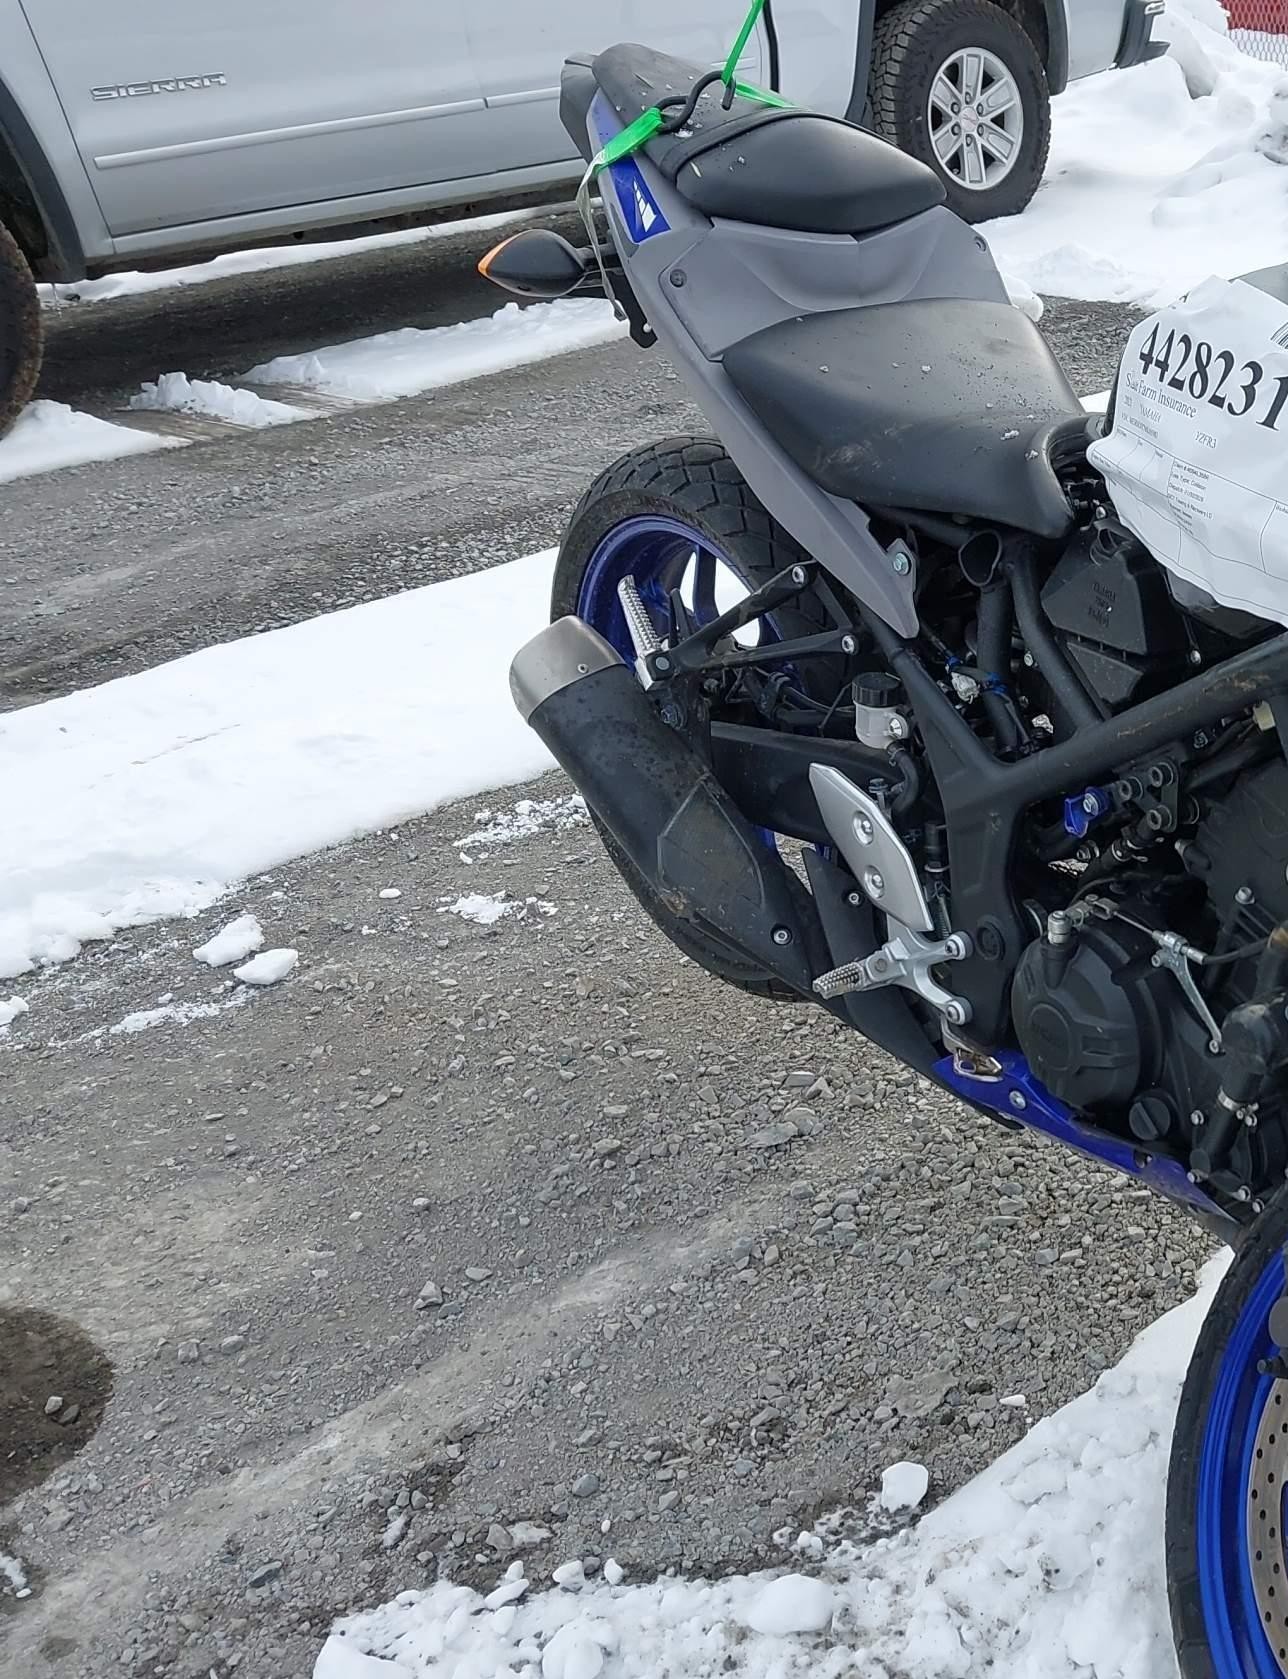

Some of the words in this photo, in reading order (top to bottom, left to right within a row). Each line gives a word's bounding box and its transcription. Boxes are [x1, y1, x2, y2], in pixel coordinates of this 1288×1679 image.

[90, 71, 227, 101] SIERRA
[1157, 388, 1197, 418] Insurance
[1194, 431, 1217, 449] YZFR3
